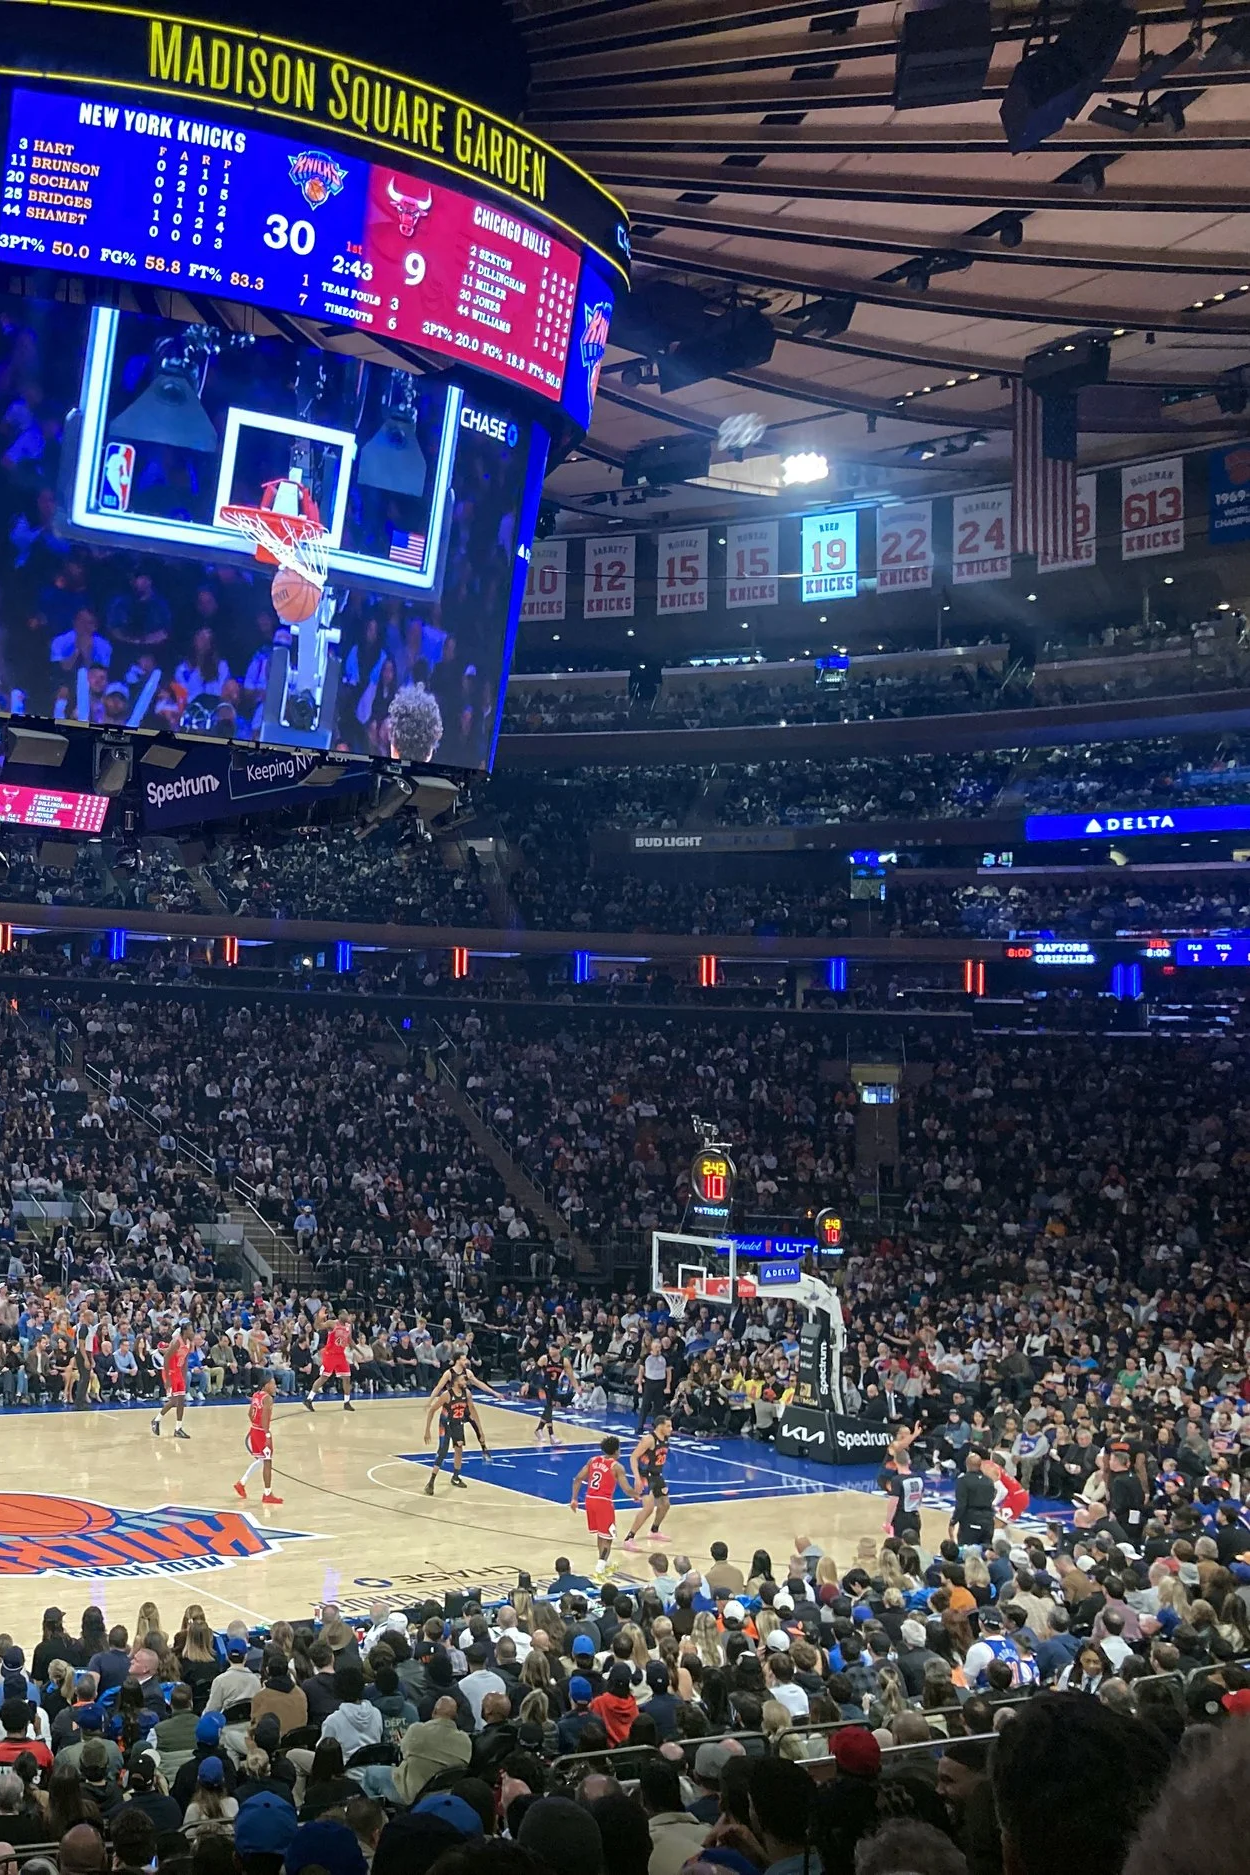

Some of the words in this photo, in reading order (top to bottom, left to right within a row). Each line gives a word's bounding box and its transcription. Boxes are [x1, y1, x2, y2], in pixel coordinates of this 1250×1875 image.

[150, 20, 316, 111] MADISON
[329, 62, 446, 153] SQUARE
[455, 108, 547, 201] GARDEN
[79, 103, 119, 128] NEW
[125, 110, 172, 139] YORK
[178, 120, 246, 153] KNICKS
[19, 138, 28, 149] 3
[33, 140, 74, 156] HART
[157, 160, 166, 171] 0
[179, 164, 188, 175] 2
[202, 168, 209, 180] 1
[223, 173, 230, 184] 1
[293, 155, 343, 186] KNICKS
[6, 170, 24, 183] 20
[30, 173, 89, 192] SOCHAN
[11, 154, 26, 166] 11
[32, 157, 100, 177] BRUNSON
[155, 176, 164, 188] 0
[177, 180, 186, 192] 2
[199, 185, 208, 196] 0
[220, 189, 228, 200] 5
[4, 187, 22, 199] 25
[28, 190, 92, 209] BRIDGES
[3, 203, 20, 217] 44
[26, 207, 87, 225] SHAMET
[263, 213, 315, 255] 30
[473, 206, 520, 243] CHICAGO
[522, 228, 551, 258] BULLS
[347, 241, 362, 255] 1st
[470, 246, 477, 256] 2
[479, 249, 512, 271] SEXTON
[0, 234, 45, 252] 3PT%
[52, 241, 89, 259] 50.0
[101, 248, 136, 266] FG%
[145, 256, 181, 274] 58.8
[189, 263, 222, 282] FT%
[230, 272, 264, 290] 83.3
[332, 255, 373, 281] 2:43
[405, 252, 426, 285] 9
[462, 274, 473, 286] 11
[475, 279, 506, 300] MILLER
[469, 261, 475, 271] 7
[477, 264, 526, 294] DILLINGHAM
[302, 274, 309, 286] 1
[321, 282, 349, 297] TEAM
[351, 290, 381, 306] FOULS
[390, 298, 399, 310] 3
[459, 289, 471, 302] 30
[473, 294, 500, 313] JONES
[299, 293, 308, 306] 7
[324, 303, 373, 324] TIMEOUTS
[388, 318, 397, 330] 6
[457, 305, 469, 317] 44
[472, 309, 511, 333] WILLIAMS
[422, 321, 452, 342] 3PT%
[455, 333, 479, 351] 20.0
[482, 342, 503, 361] FG%
[506, 352, 525, 371] 18.8
[528, 362, 544, 380] FT%
[546, 373, 561, 389] 50.0
[460, 407, 507, 442] CHASE
[1124, 486, 1182, 530] 613
[819, 522, 839, 532] REED
[958, 518, 1005, 555] 24
[881, 528, 927, 565] 22
[1125, 529, 1180, 552] KNICKS
[736, 548, 770, 580] 15
[812, 539, 846, 572] 19
[956, 557, 1007, 577] KNICKS
[593, 560, 626, 592] 12
[666, 554, 699, 588] 15
[879, 566, 928, 587] KNICKS
[729, 584, 775, 601] KNICKS
[806, 576, 853, 594] KNICKS
[586, 597, 631, 613] KNICKS
[660, 592, 704, 608] KNICKS
[247, 758, 294, 782] Keeping
[147, 774, 214, 808] Spectrum
[1107, 815, 1174, 831] DELTA
[635, 837, 662, 848] BUD
[664, 836, 702, 848] LIGHT
[1035, 955, 1095, 964] GRIZZLIES
[1036, 944, 1089, 953] RAPTORS
[706, 1176, 724, 1199] 10
[703, 1207, 729, 1216] TISSOT
[827, 1230, 838, 1242] 10
[773, 1269, 796, 1277] DELTA
[819, 1341, 828, 1395] Spectrum
[591, 1471, 602, 1490] 2
[57, 1563, 151, 1579] YORK
[156, 1556, 225, 1573] NEW
[392, 1565, 523, 1584] CHASE
